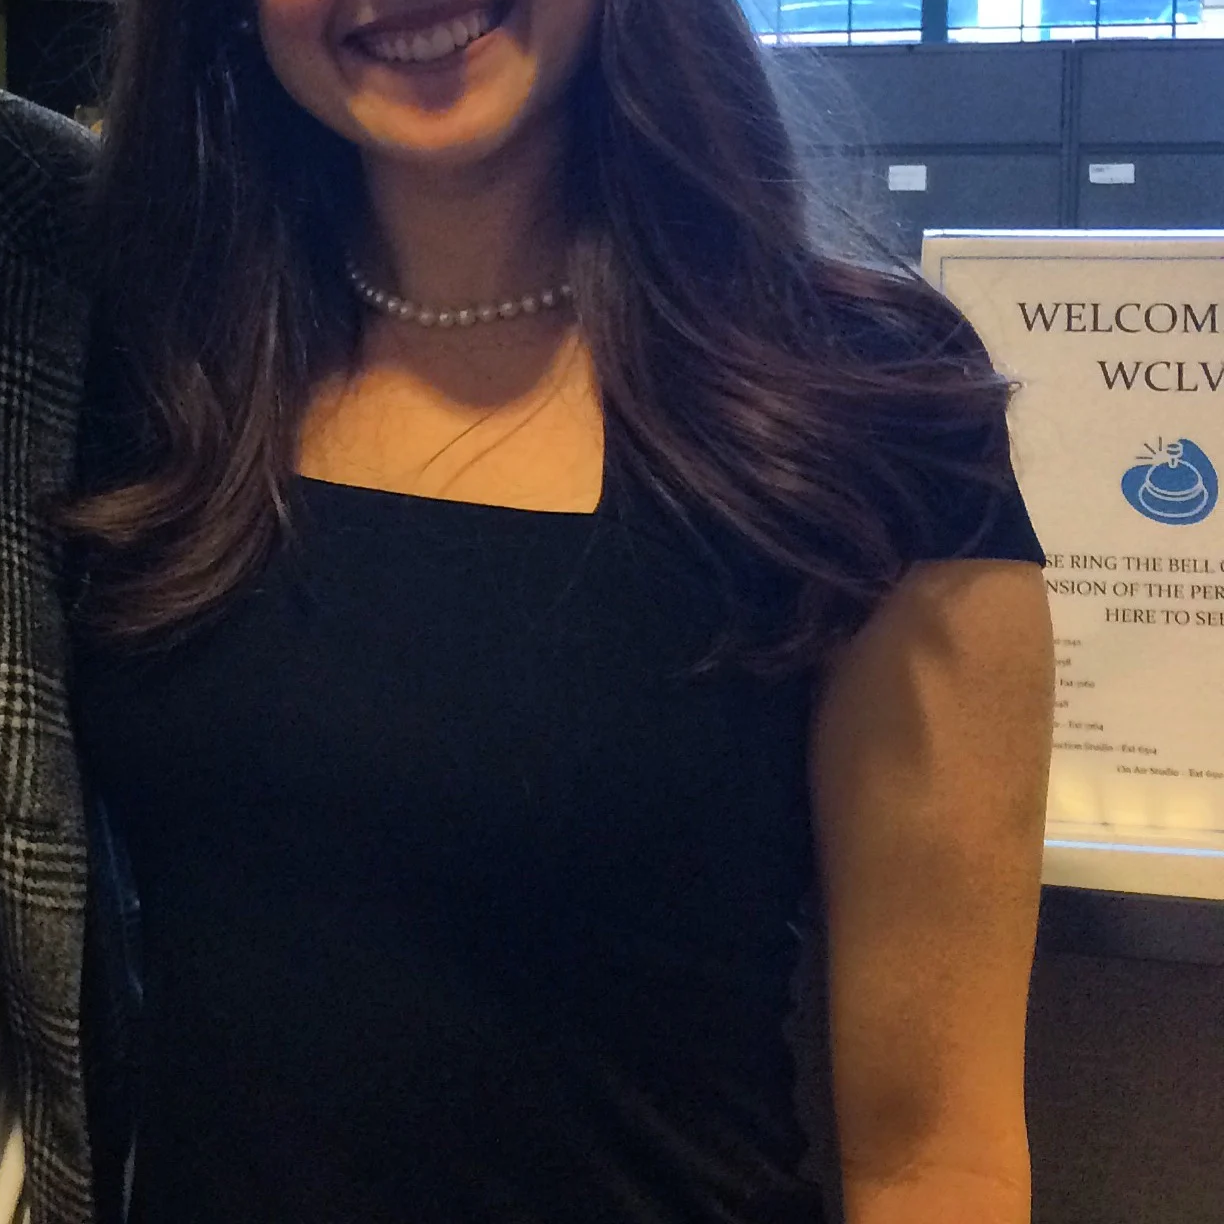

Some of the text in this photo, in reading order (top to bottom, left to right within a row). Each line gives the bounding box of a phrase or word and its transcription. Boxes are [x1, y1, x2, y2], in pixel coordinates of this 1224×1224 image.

[1016, 302, 1224, 333] WELCOM
[1097, 360, 1224, 392] WCLV
[1070, 554, 1117, 571] RING
[1122, 556, 1163, 572] THE
[1168, 557, 1216, 574] BELL
[1113, 581, 1139, 597] OF
[1143, 583, 1185, 599] THE
[1105, 607, 1156, 624] HERE
[1160, 609, 1191, 625] TO
